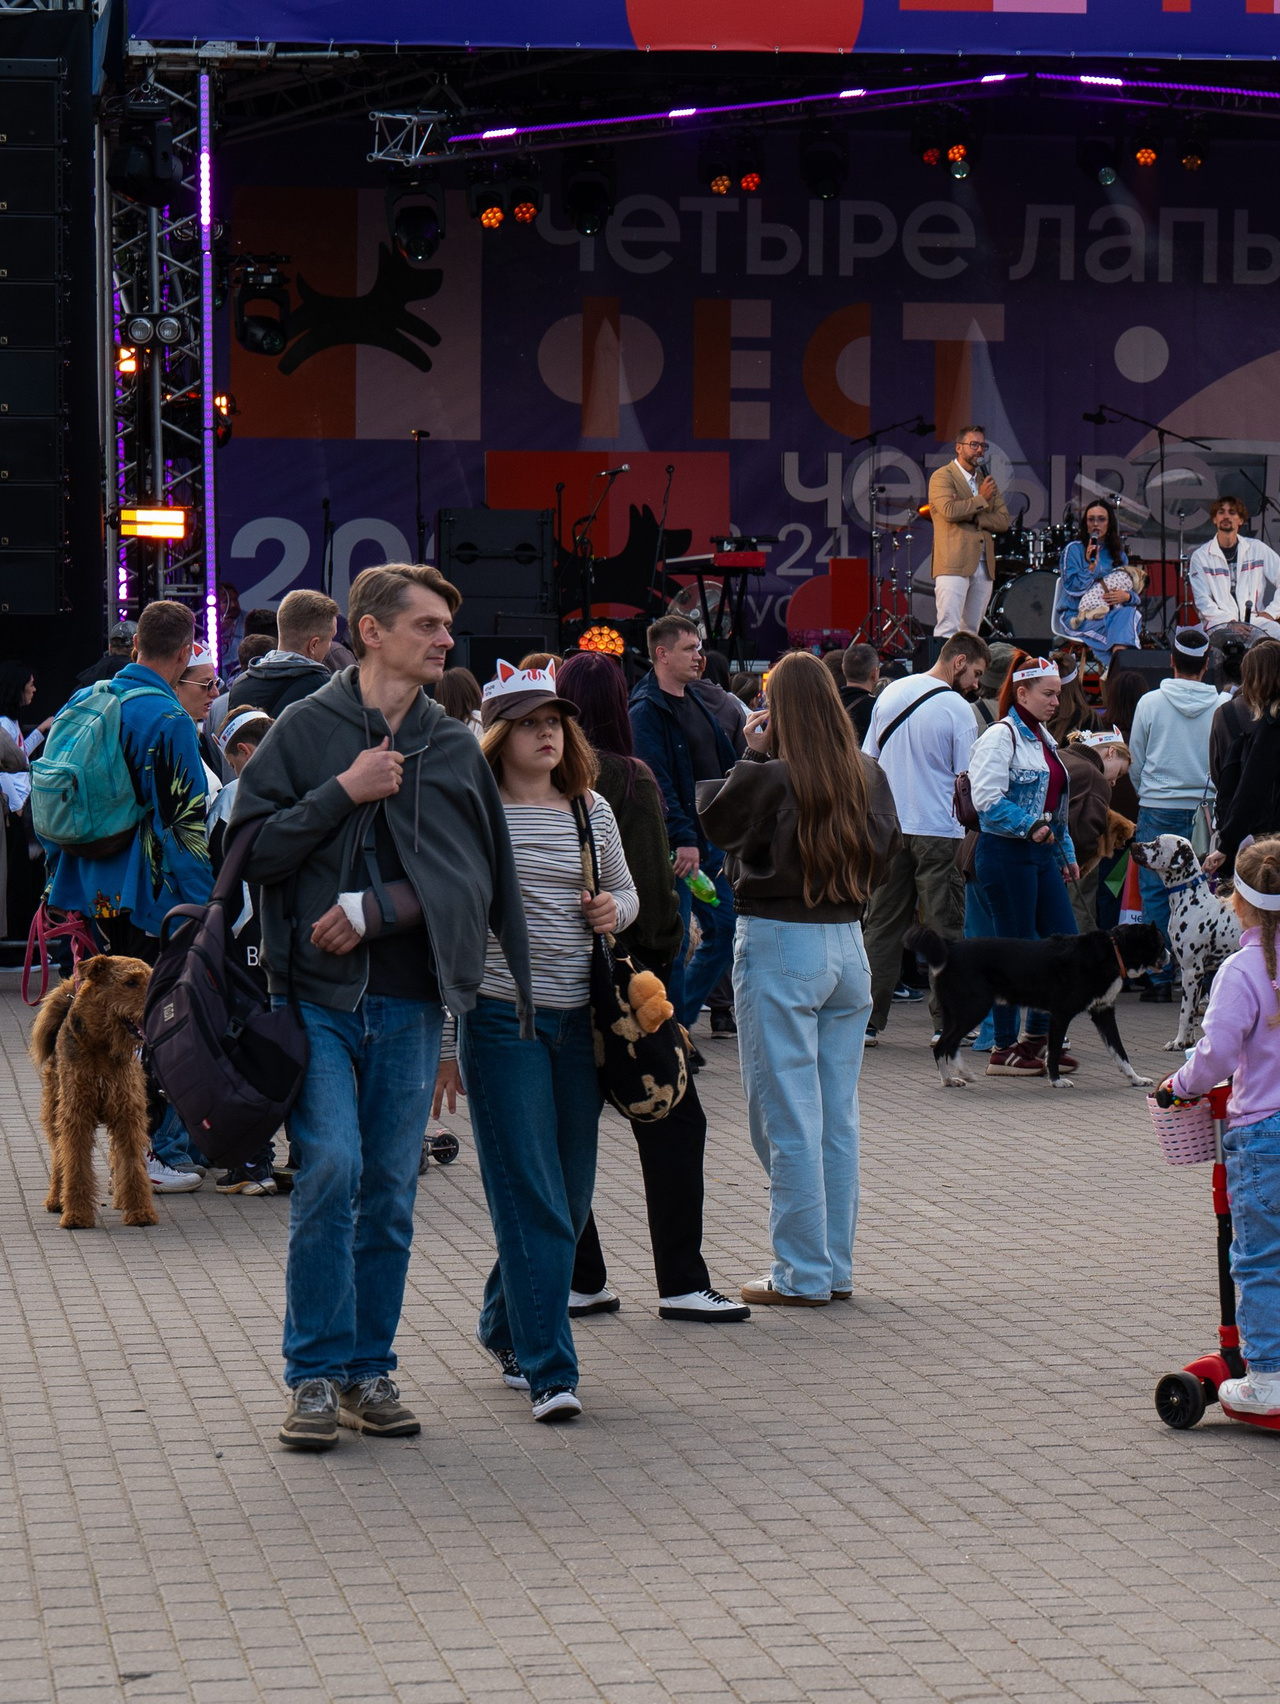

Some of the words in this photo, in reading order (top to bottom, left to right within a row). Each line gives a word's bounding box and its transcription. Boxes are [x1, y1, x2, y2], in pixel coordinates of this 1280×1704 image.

[535, 194, 977, 280] четыре
[537, 296, 1005, 443] ФЕСТ
[783, 446, 1219, 534] чеыре
